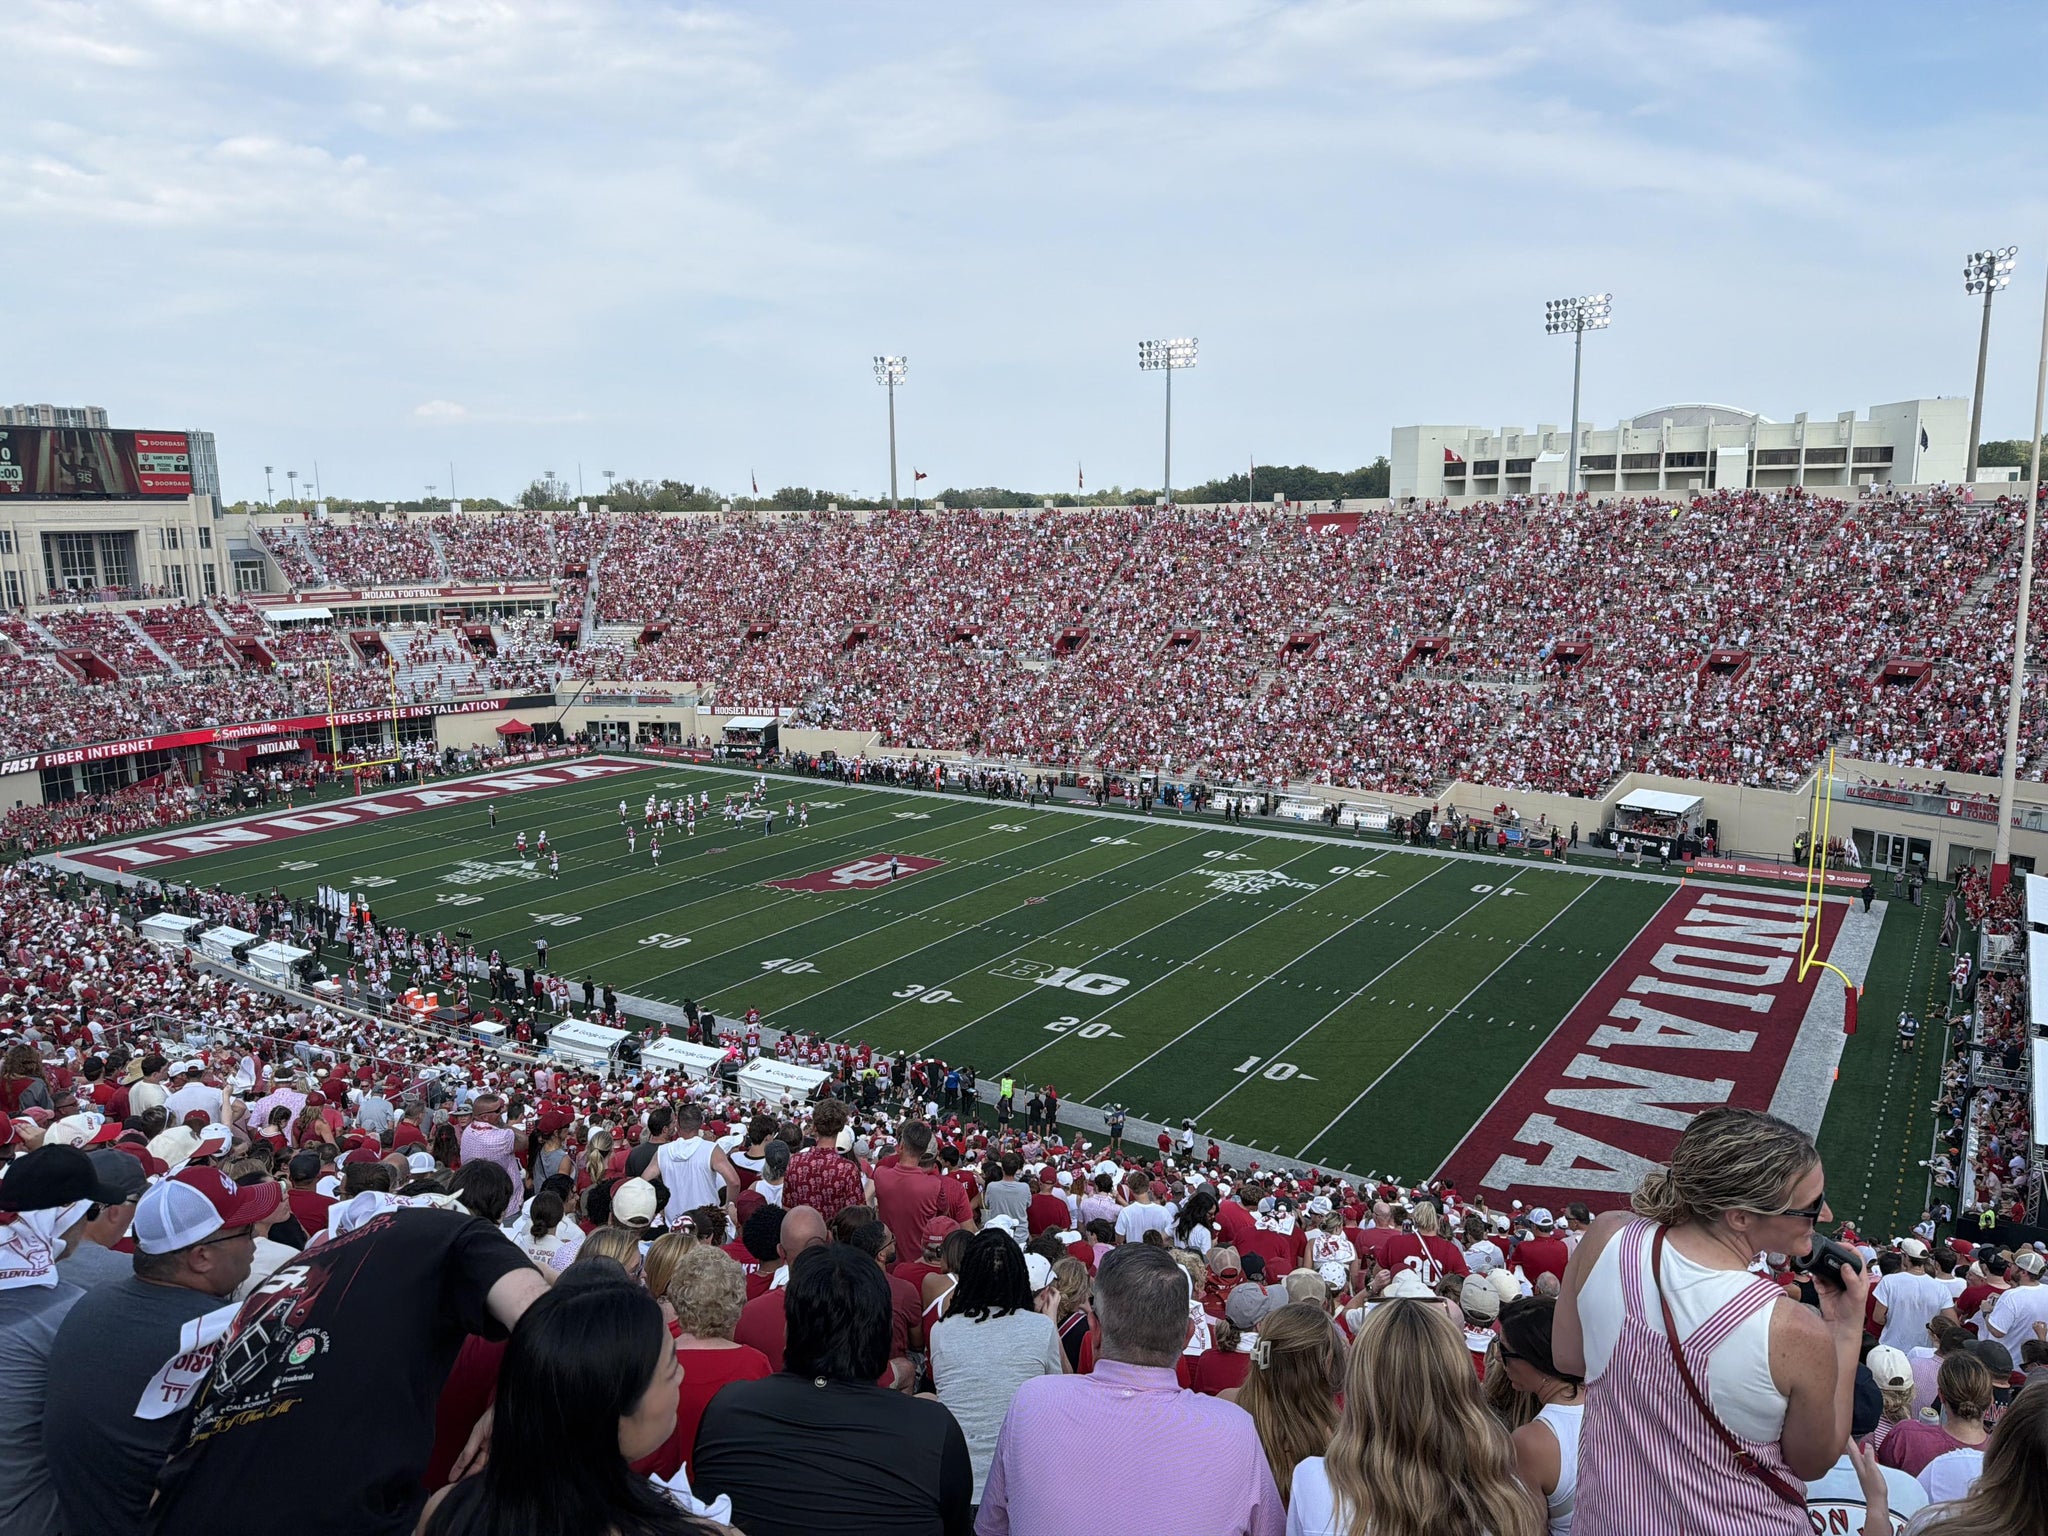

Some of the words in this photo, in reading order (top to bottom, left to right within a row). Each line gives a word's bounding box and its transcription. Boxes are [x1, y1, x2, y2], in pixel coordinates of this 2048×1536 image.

[1, 447, 11, 460] 0
[361, 589, 396, 600] INDIANA
[398, 588, 441, 599] FOOTBALL
[326, 709, 406, 727] STRESS-FREE
[410, 701, 499, 719] INSTALLATION
[714, 707, 746, 715] HOOSIER
[748, 707, 775, 715] NATION
[222, 724, 277, 738] Smithville
[257, 740, 300, 754] INDIANA
[1, 757, 38, 774] FAST
[44, 750, 84, 767] FIBER
[88, 739, 153, 759] INTERNET
[93, 763, 638, 865] INDIANA
[1697, 861, 1734, 870] NISSAN
[1192, 869, 1320, 890] MERCHANTS
[1205, 882, 1262, 895] FIELD
[638, 933, 692, 949] 50
[760, 957, 815, 975] 40
[892, 984, 953, 1004] 30
[1043, 1016, 1112, 1039] 20
[1479, 893, 1817, 1194] INDIANA
[773, 1069, 796, 1081] Google
[1233, 1055, 1299, 1081] 10
[298, 1328, 321, 1339] BOWL
[282, 1373, 314, 1384] Prudential
